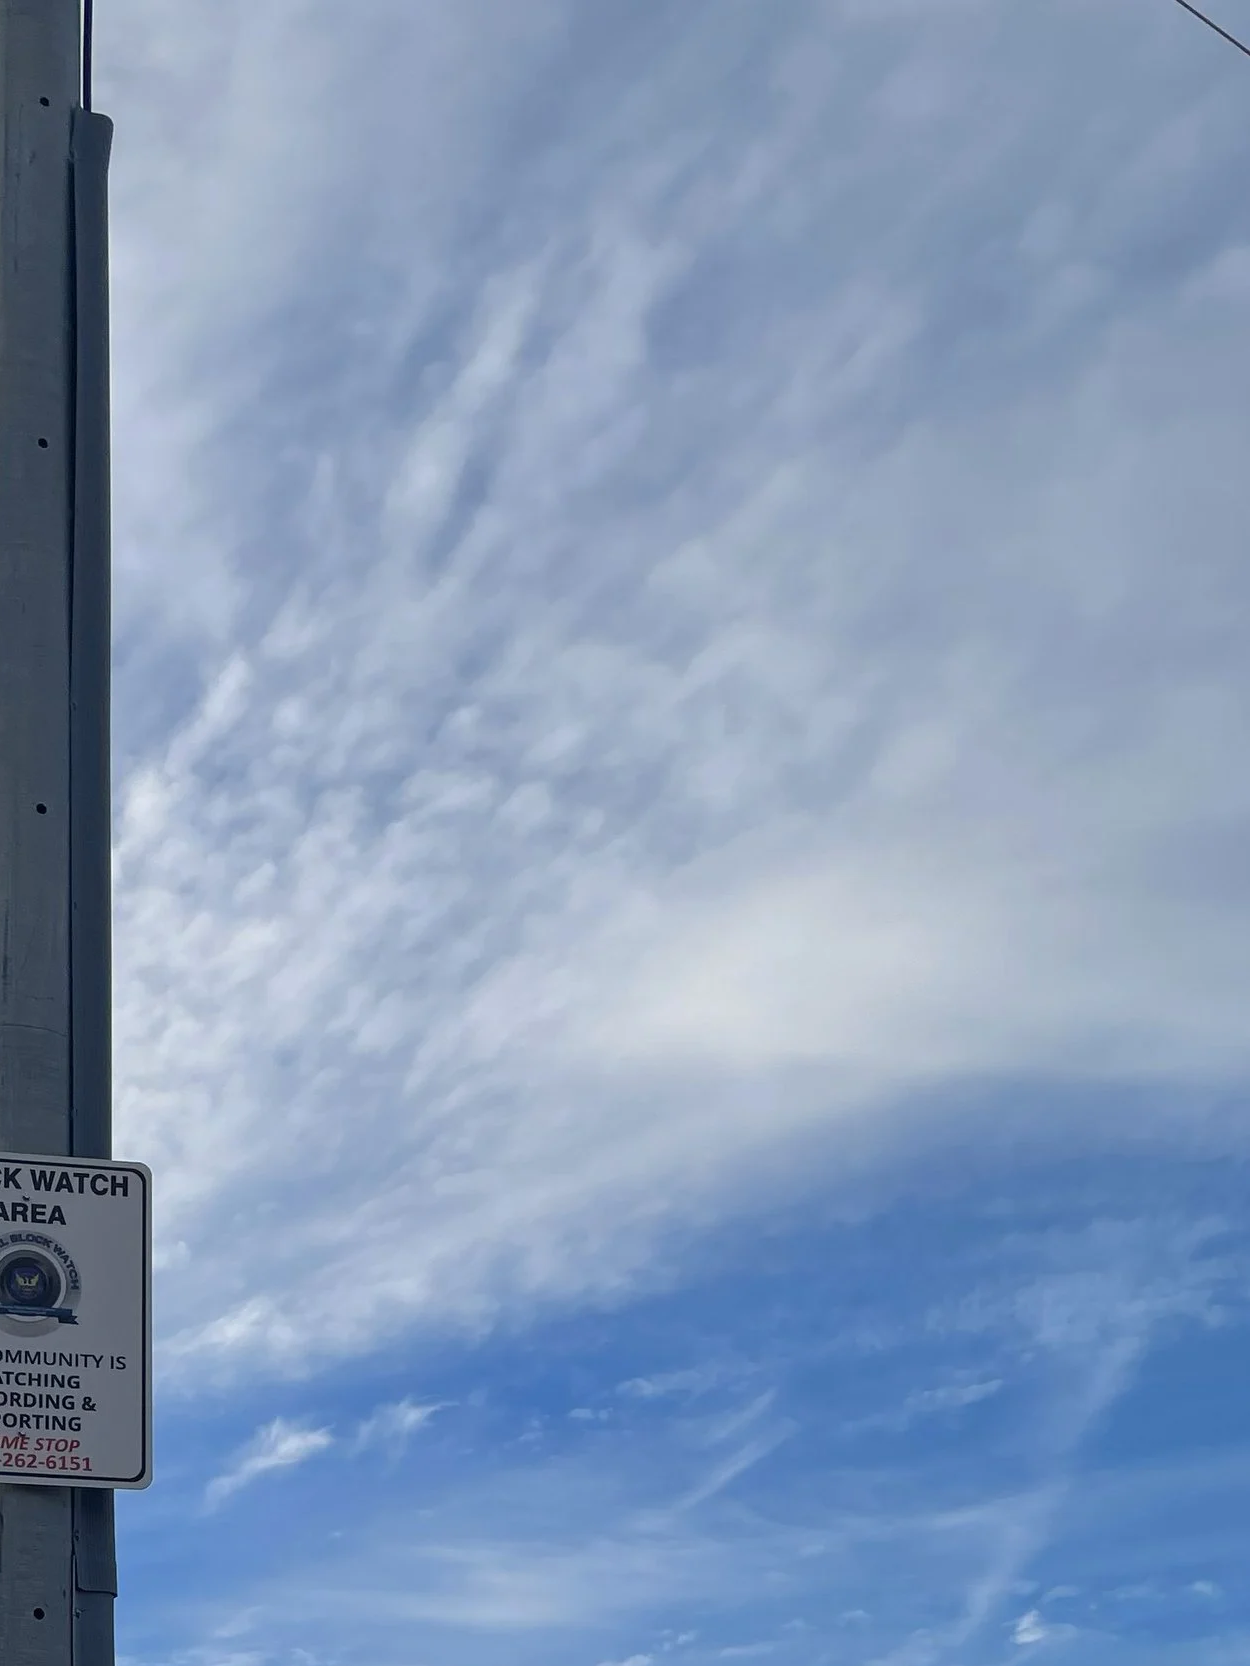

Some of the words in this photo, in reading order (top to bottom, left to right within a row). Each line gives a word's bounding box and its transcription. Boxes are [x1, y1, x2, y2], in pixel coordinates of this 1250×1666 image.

[30, 1168, 129, 1197] WATCH
[10, 1233, 53, 1248] BLOCK
[53, 1244, 80, 1290] WATCH
[110, 1355, 127, 1370] IS
[81, 1396, 97, 1412] &
[34, 1437, 81, 1453] STOP
